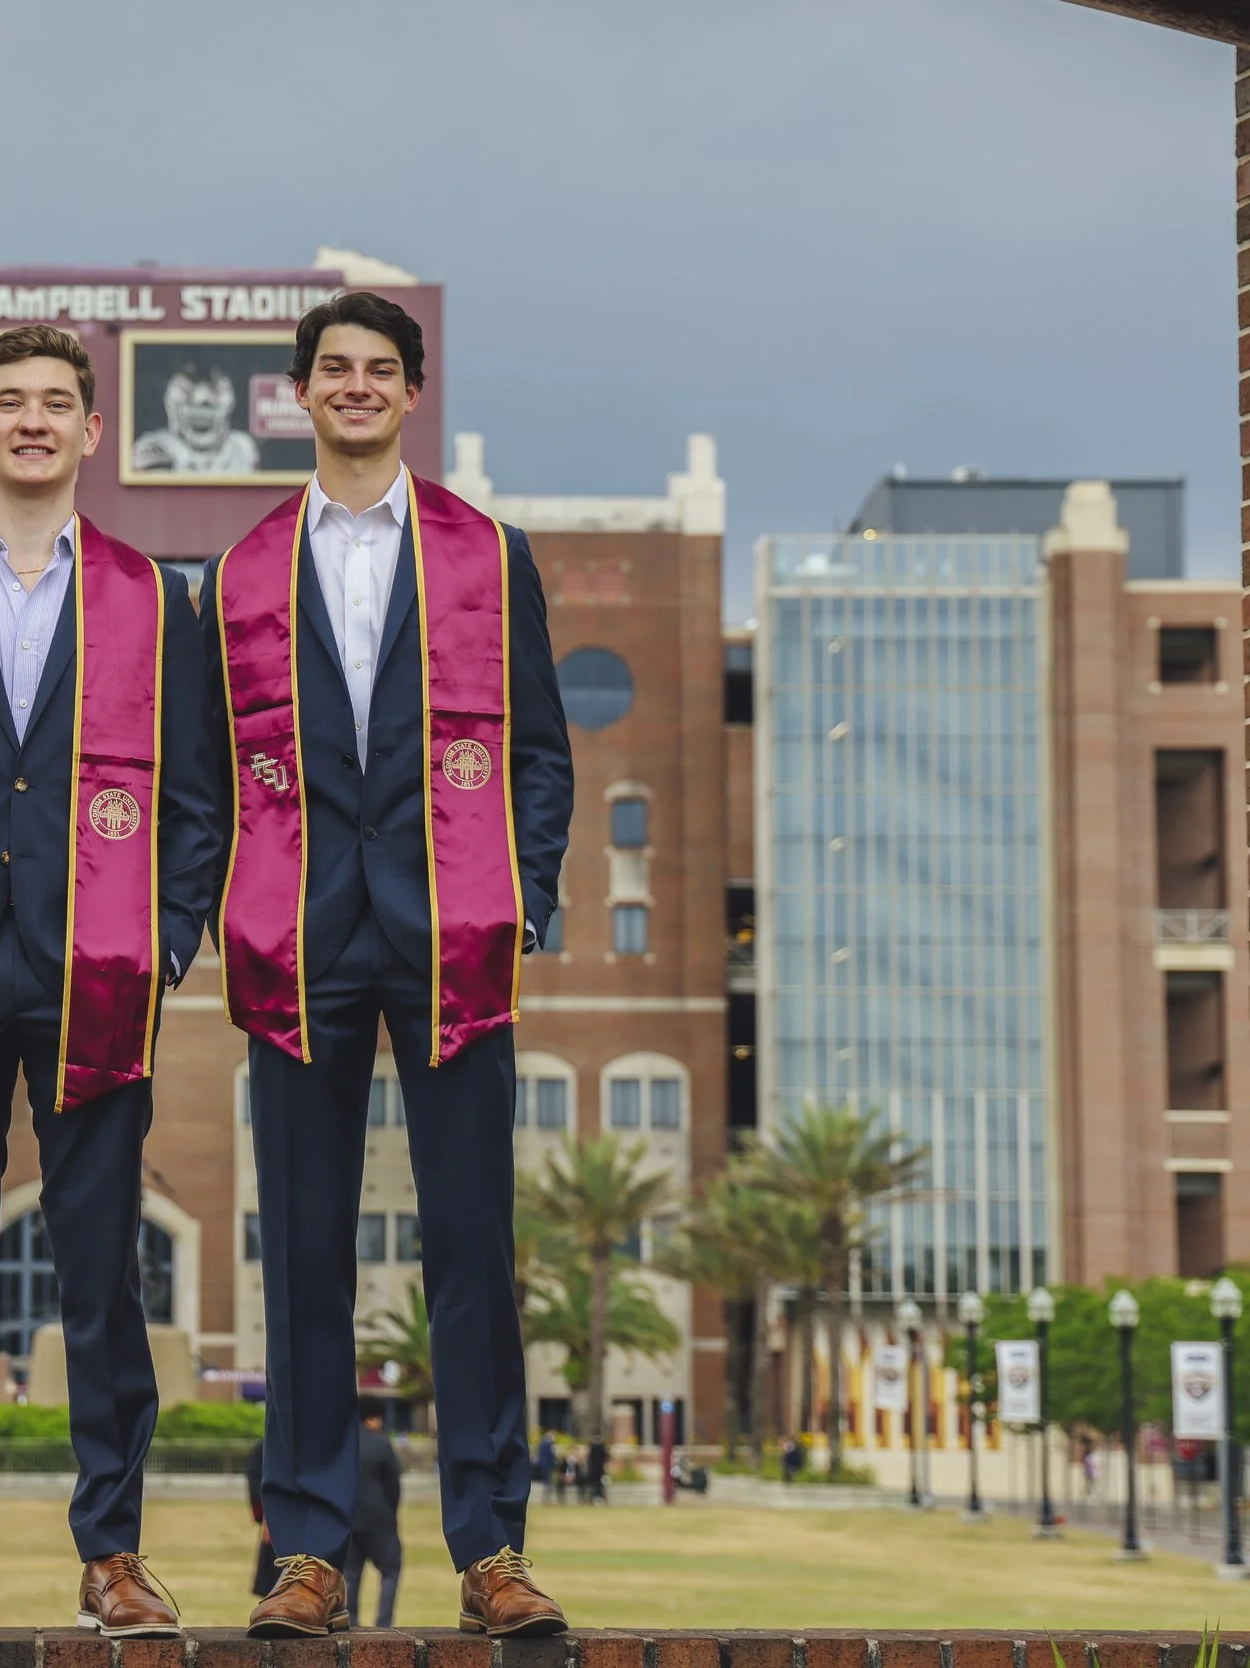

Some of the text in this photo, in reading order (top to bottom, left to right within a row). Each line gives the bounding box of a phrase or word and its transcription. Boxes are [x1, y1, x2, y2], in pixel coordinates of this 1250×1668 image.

[453, 742, 472, 750] STATE
[250, 753, 290, 792] FSU
[92, 798, 103, 826] FLORIDA
[102, 791, 121, 799] STATE
